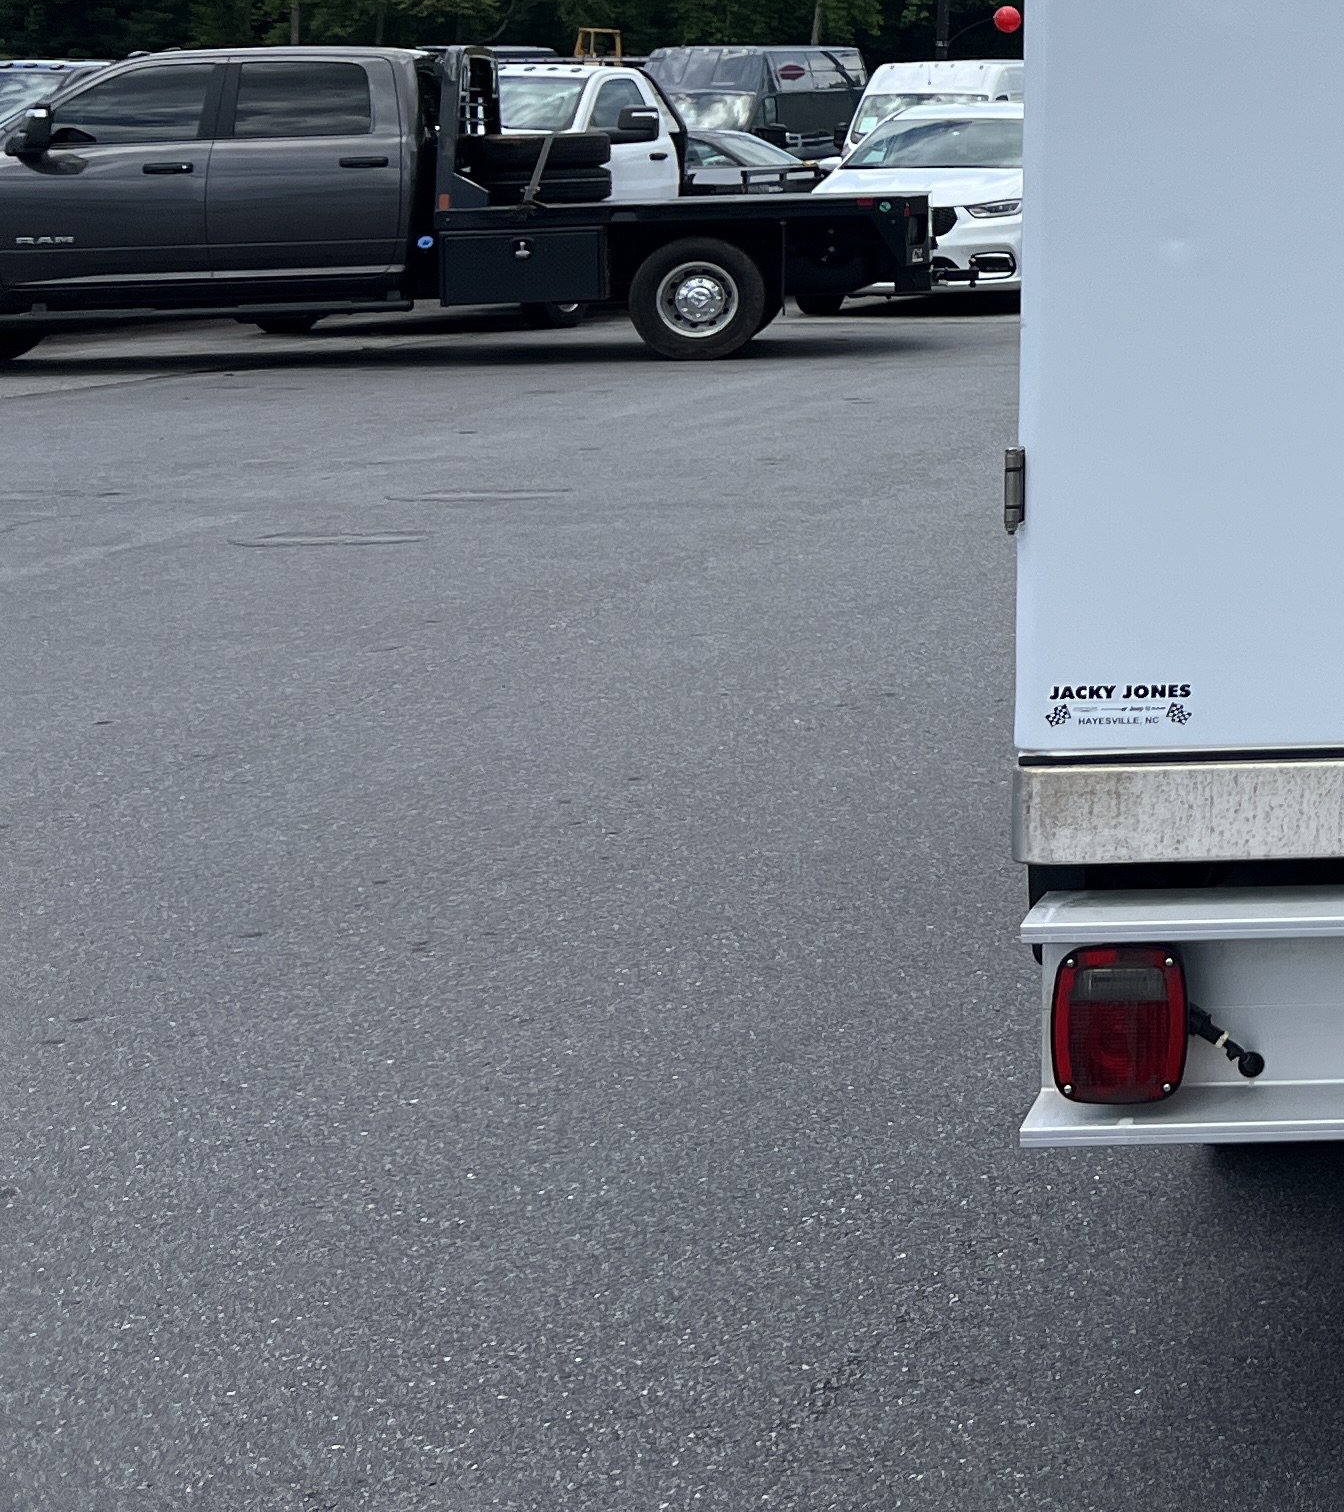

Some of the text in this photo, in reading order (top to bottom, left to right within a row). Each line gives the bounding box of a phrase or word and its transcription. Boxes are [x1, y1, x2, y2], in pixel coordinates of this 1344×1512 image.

[15, 236, 75, 245] RAM
[1049, 683, 1192, 700] JACKY JONES
[1145, 716, 1159, 724] NC
